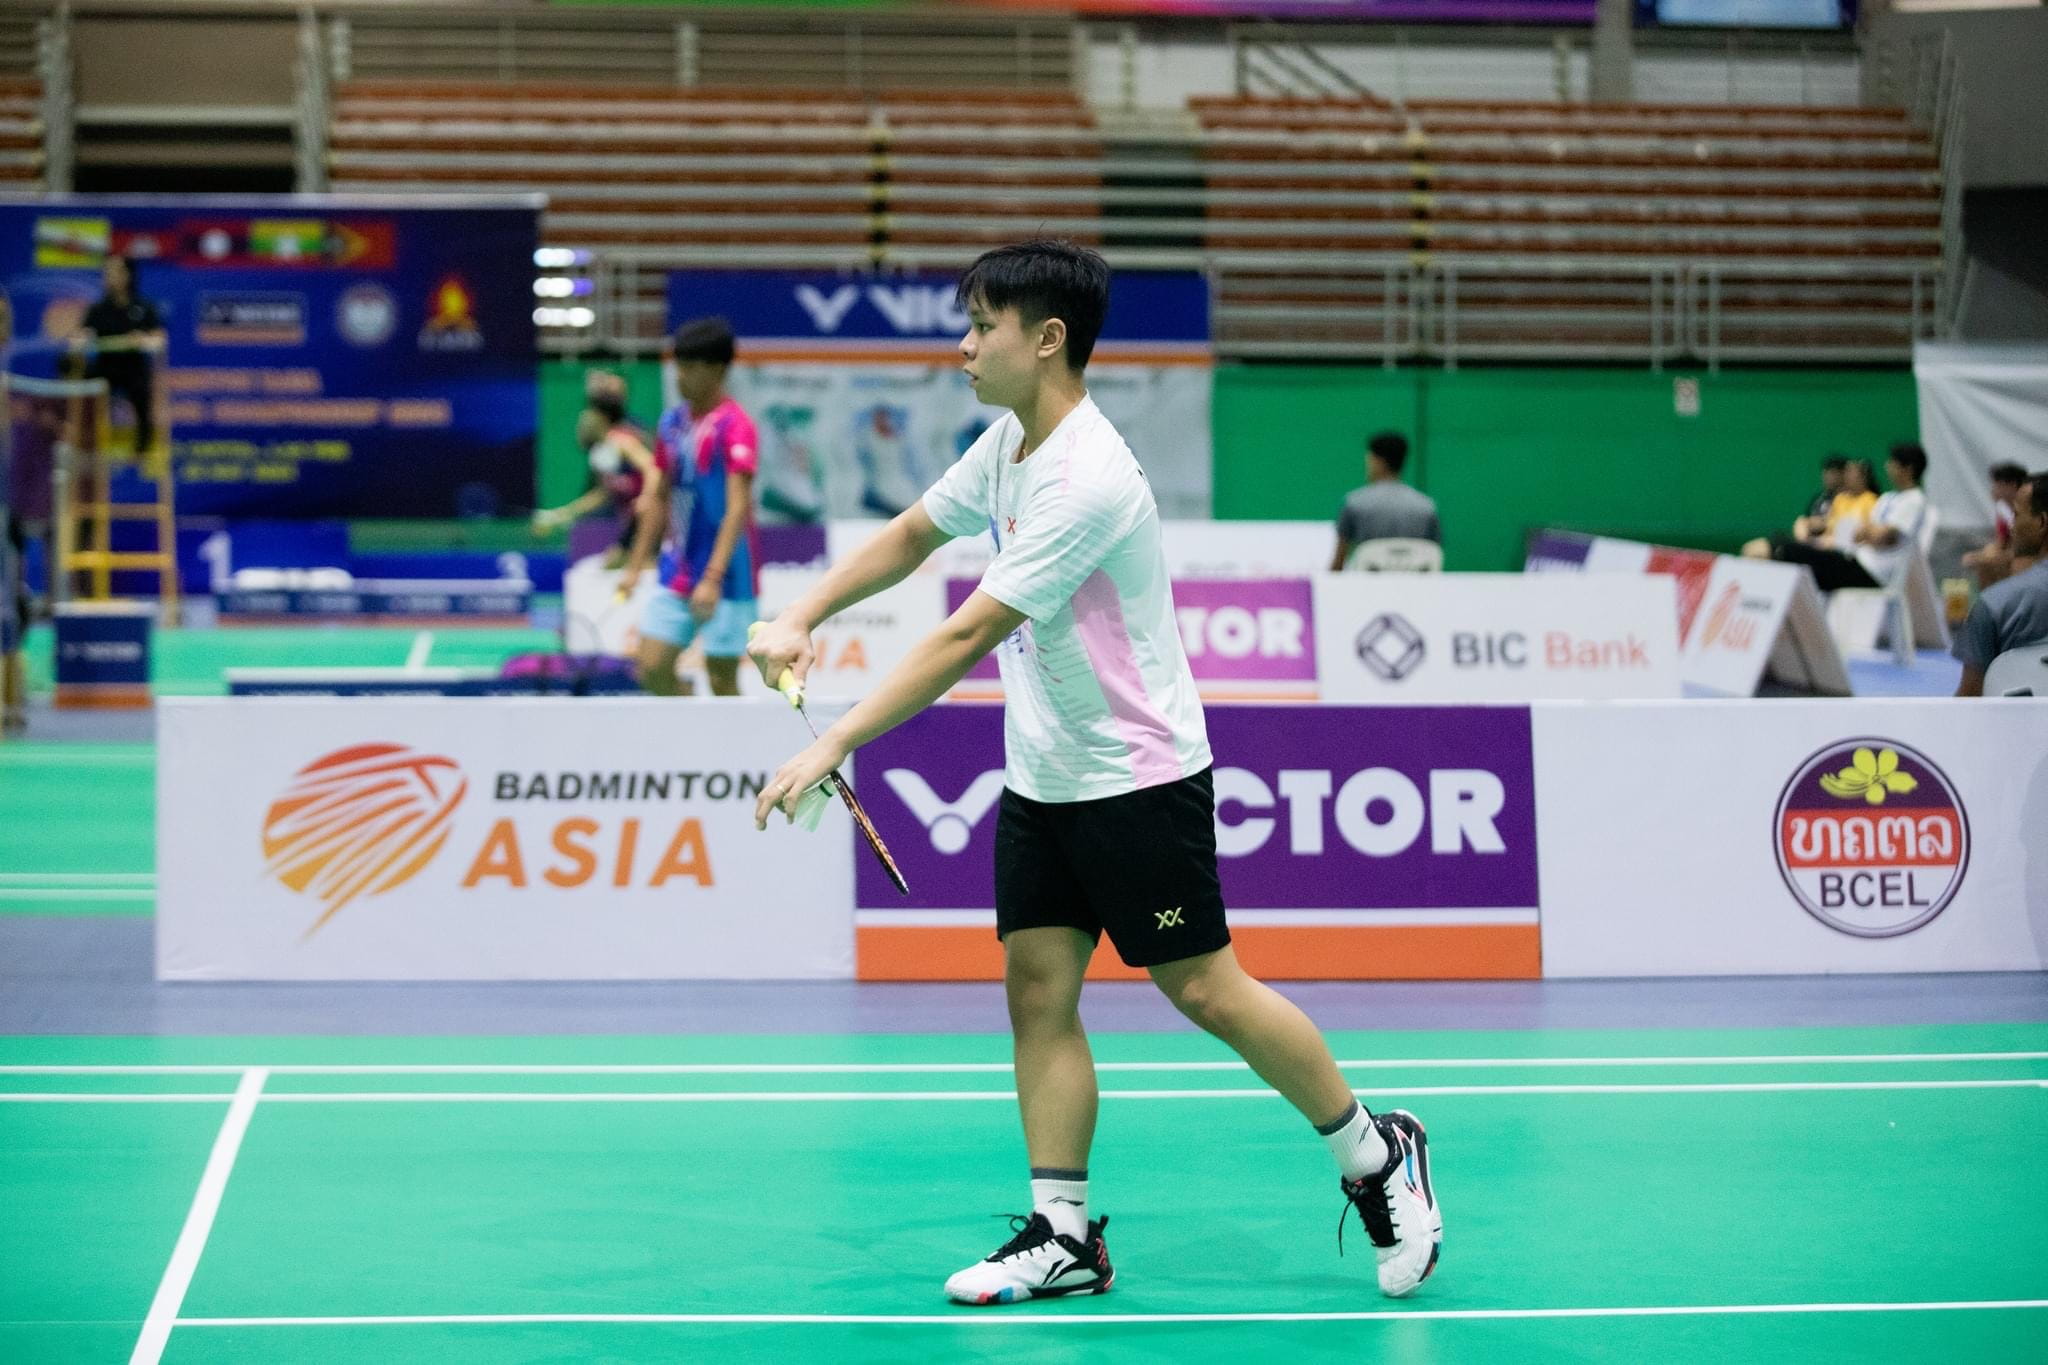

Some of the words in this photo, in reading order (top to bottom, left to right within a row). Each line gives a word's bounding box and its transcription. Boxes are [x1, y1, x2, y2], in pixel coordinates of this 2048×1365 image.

[864, 284, 971, 334] VIC
[1176, 605, 1304, 660] TOR
[1452, 631, 1527, 667] BIC
[1545, 631, 1649, 669] Bank
[495, 772, 768, 801] BADMINTON
[1212, 766, 1507, 857] CTOR
[461, 816, 715, 888] ASIA
[1819, 870, 1931, 908] BCEL
